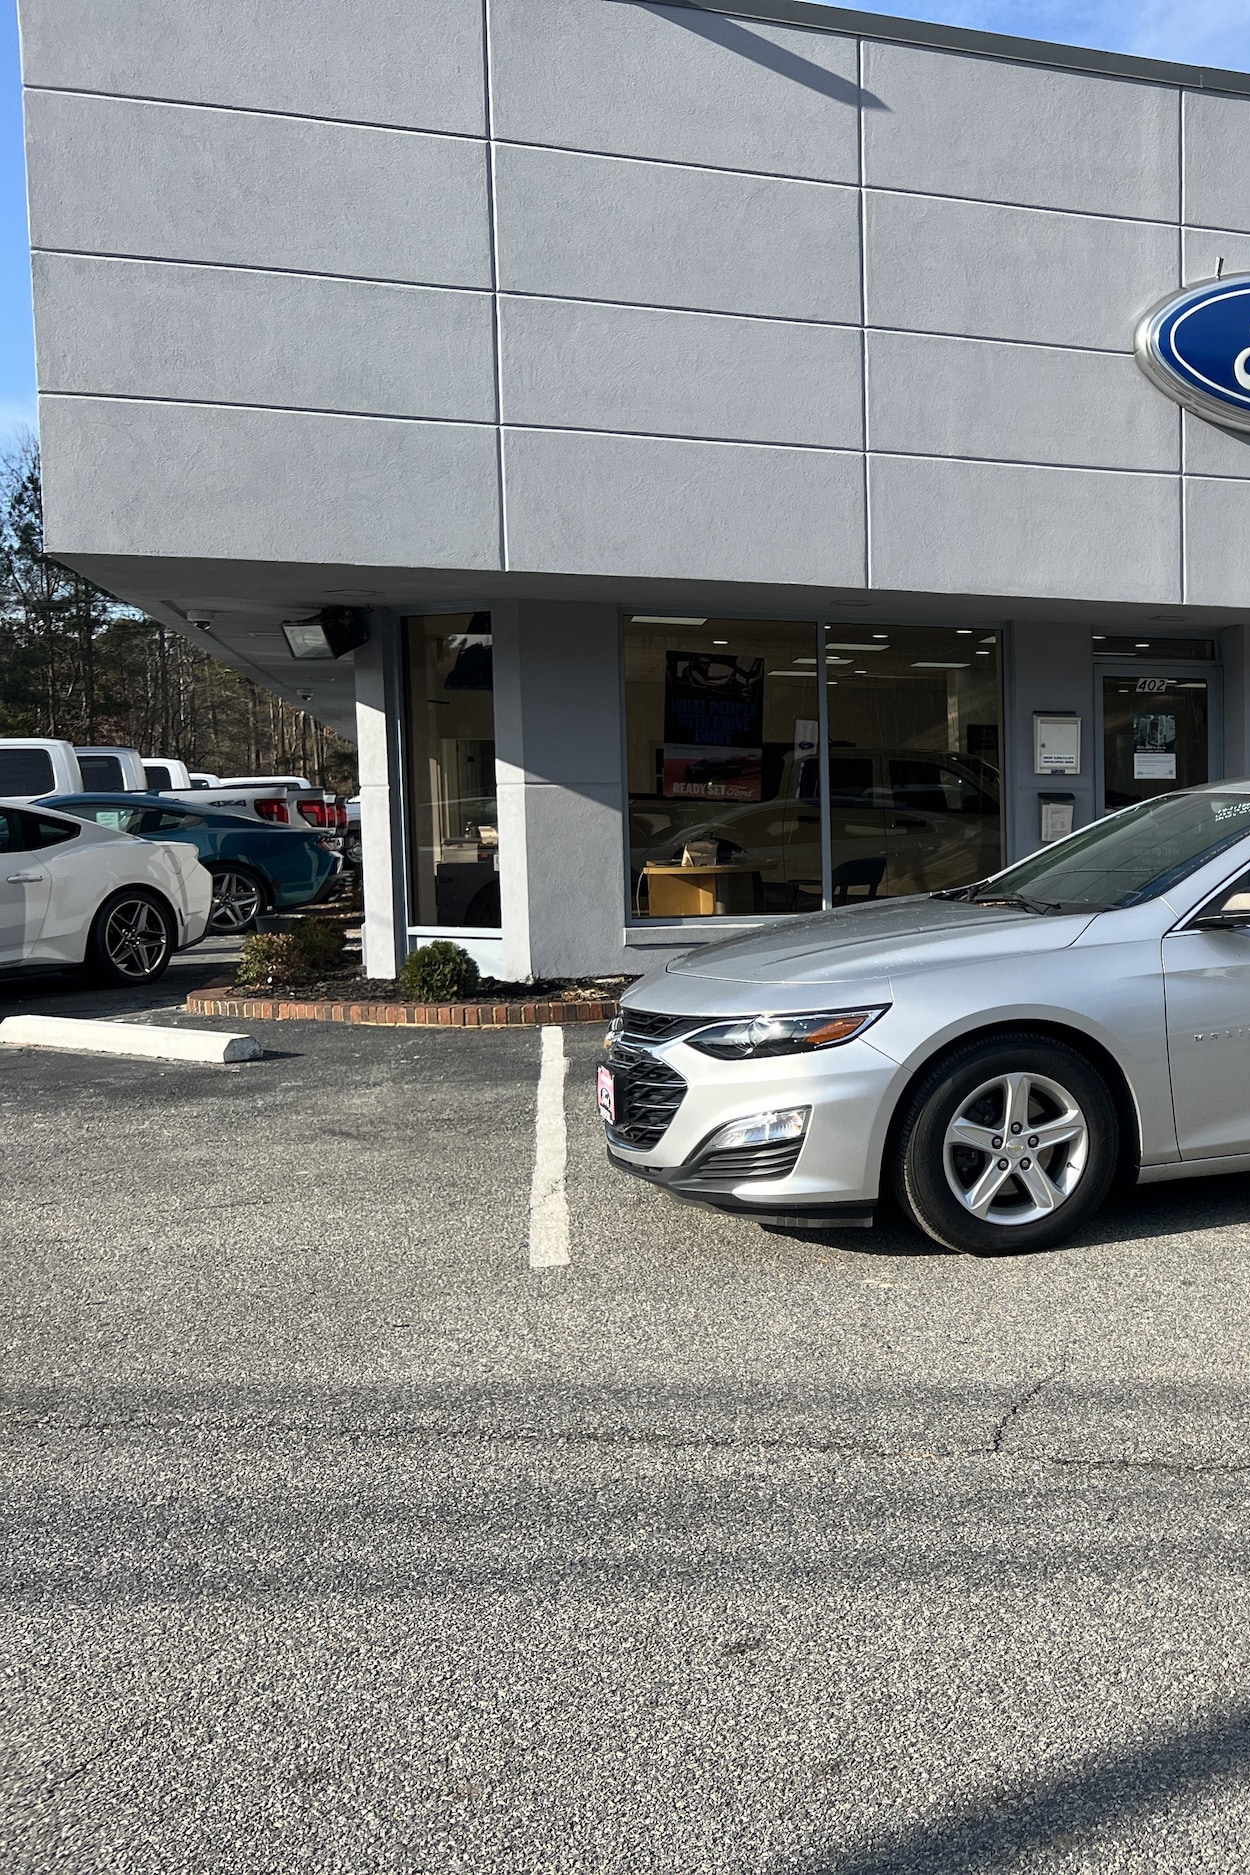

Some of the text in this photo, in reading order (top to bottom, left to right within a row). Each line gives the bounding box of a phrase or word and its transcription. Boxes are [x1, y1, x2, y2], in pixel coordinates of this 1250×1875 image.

[1138, 679, 1166, 692] 402
[673, 782, 754, 797] READY SET Ford
